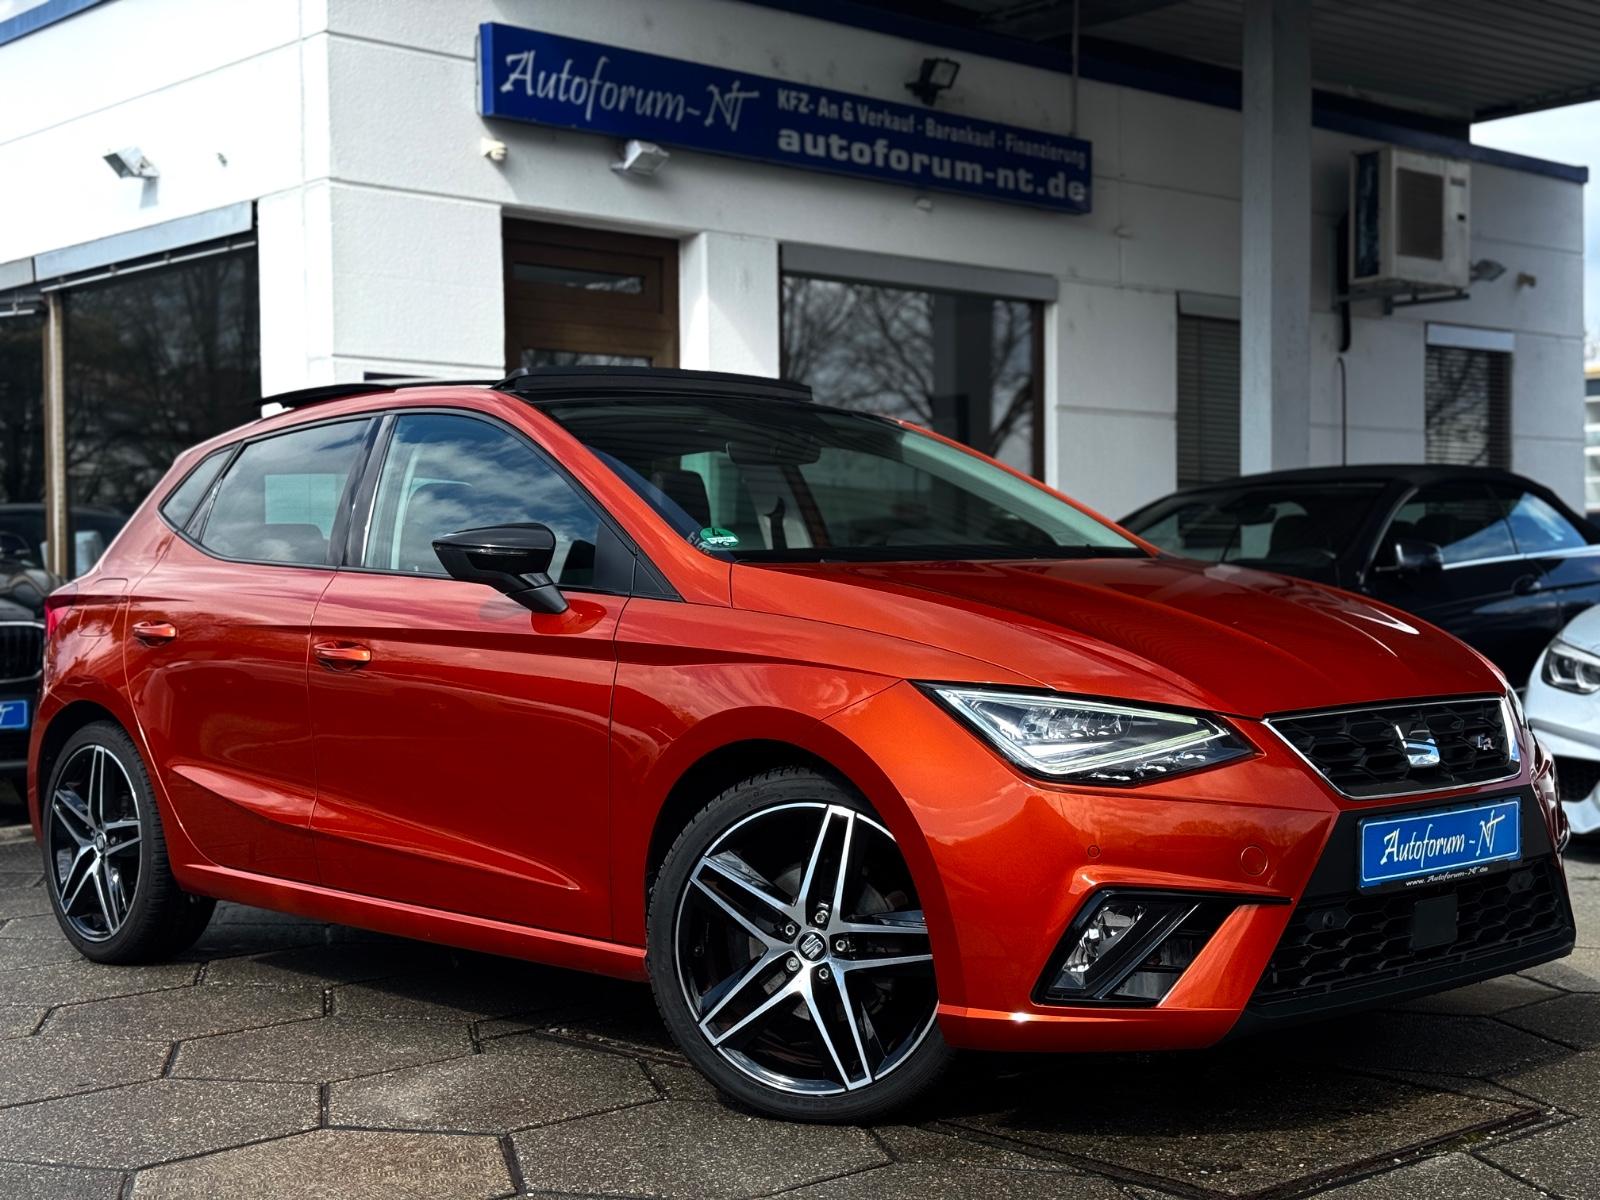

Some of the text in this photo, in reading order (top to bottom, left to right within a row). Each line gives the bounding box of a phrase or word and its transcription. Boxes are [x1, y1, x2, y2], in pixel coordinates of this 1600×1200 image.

[778, 88, 815, 114] KFZ-
[818, 96, 839, 121] An
[842, 101, 854, 123] &
[857, 104, 916, 133] Verkauf
[925, 118, 996, 148] Barankauf
[1005, 133, 1086, 170] Finanzierung
[778, 128, 1087, 202] autoforum-nt.de
